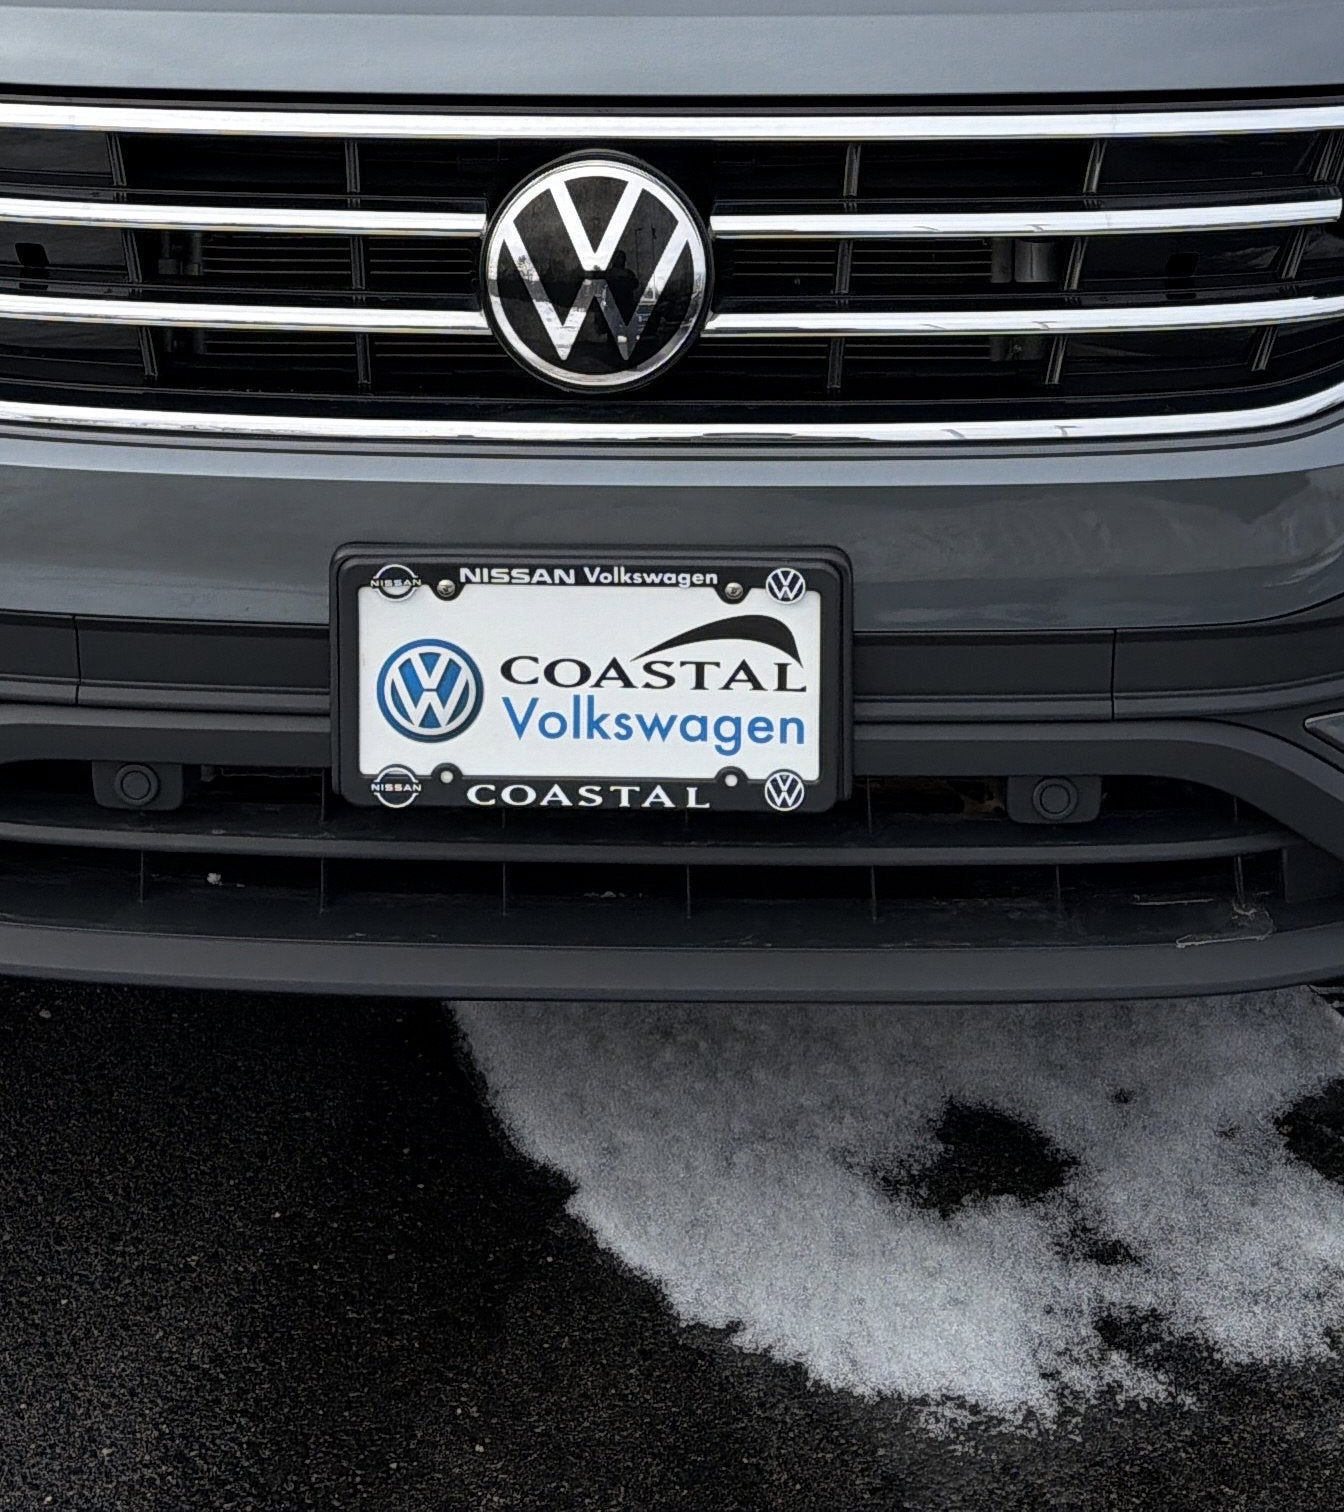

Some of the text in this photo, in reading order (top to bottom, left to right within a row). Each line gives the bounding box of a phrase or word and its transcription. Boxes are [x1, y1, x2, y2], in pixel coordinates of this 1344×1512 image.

[370, 578, 422, 588] NISSAN
[460, 566, 719, 587] NISSAN Volkswagen
[500, 655, 807, 693] COASTAL
[502, 694, 806, 757] Volkswagen
[370, 783, 422, 792] NISSAN
[466, 783, 712, 809] COASTAL
